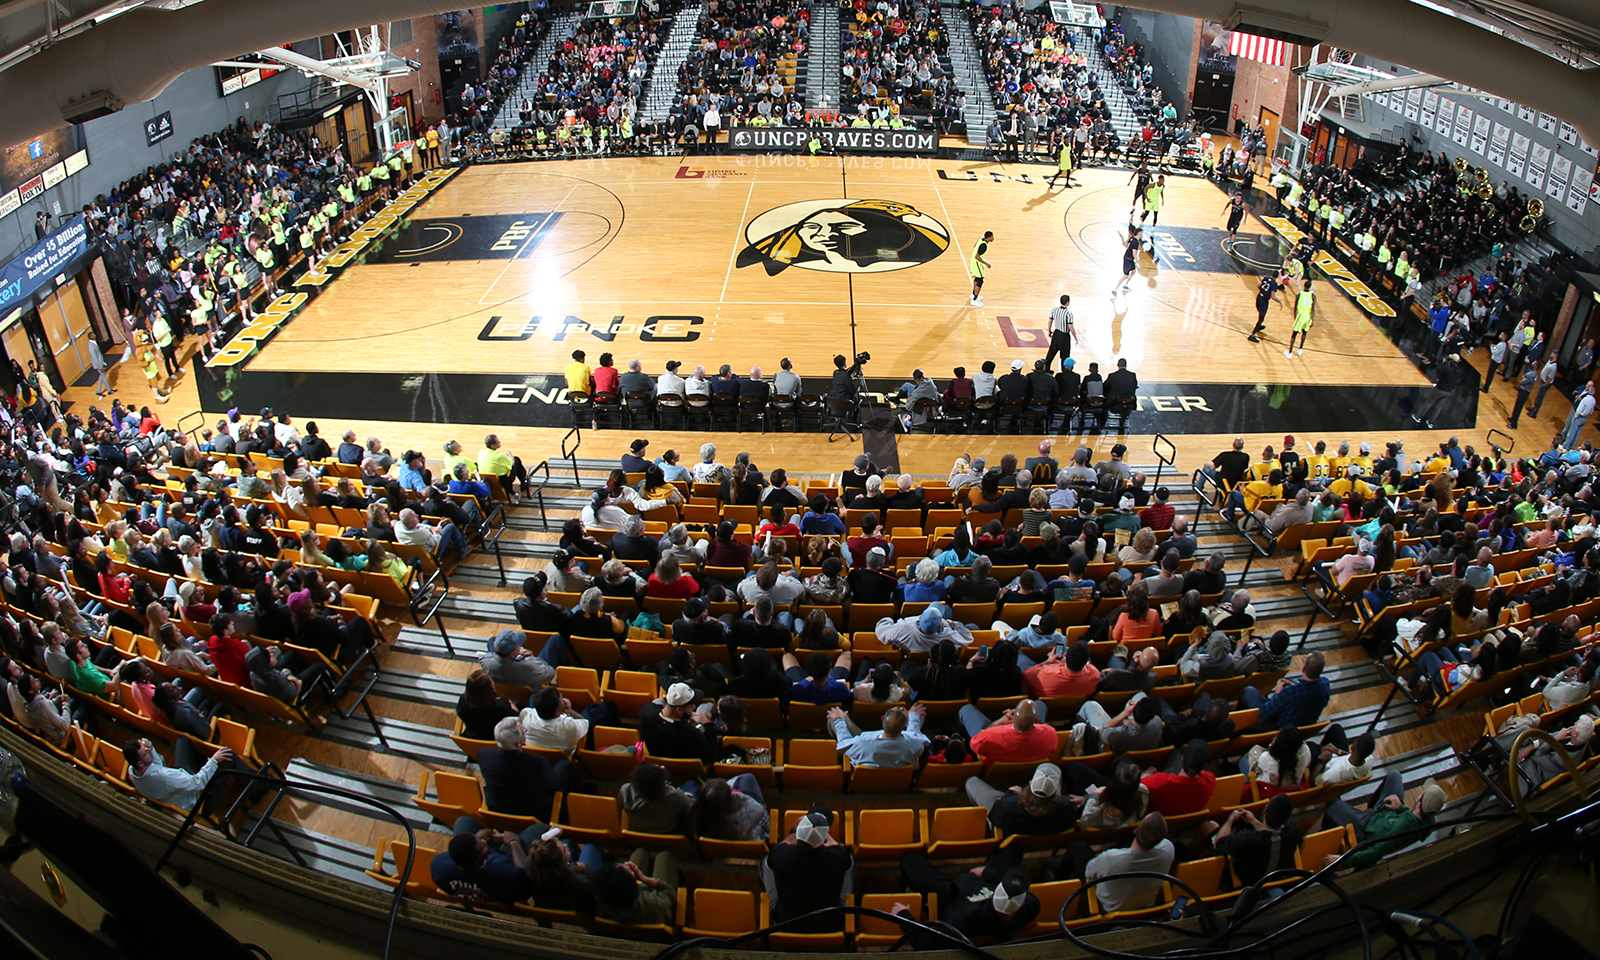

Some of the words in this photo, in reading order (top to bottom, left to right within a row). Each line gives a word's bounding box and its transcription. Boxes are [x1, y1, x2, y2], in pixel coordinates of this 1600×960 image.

[754, 131, 934, 150] UNCPRAVES.COM
[22, 189, 35, 202] FOX
[35, 184, 42, 193] TV
[24, 248, 47, 269] Over
[46, 239, 57, 252] $5
[56, 223, 85, 246] Billion
[490, 219, 539, 251] PBC
[1153, 232, 1196, 263] PBC
[27, 259, 49, 280] Raised
[48, 253, 59, 265] for
[58, 233, 88, 257] Education
[1261, 280, 1270, 292] 23
[204, 292, 309, 368] UNC
[477, 315, 704, 342] UNC
[1314, 464, 1330, 478] 33
